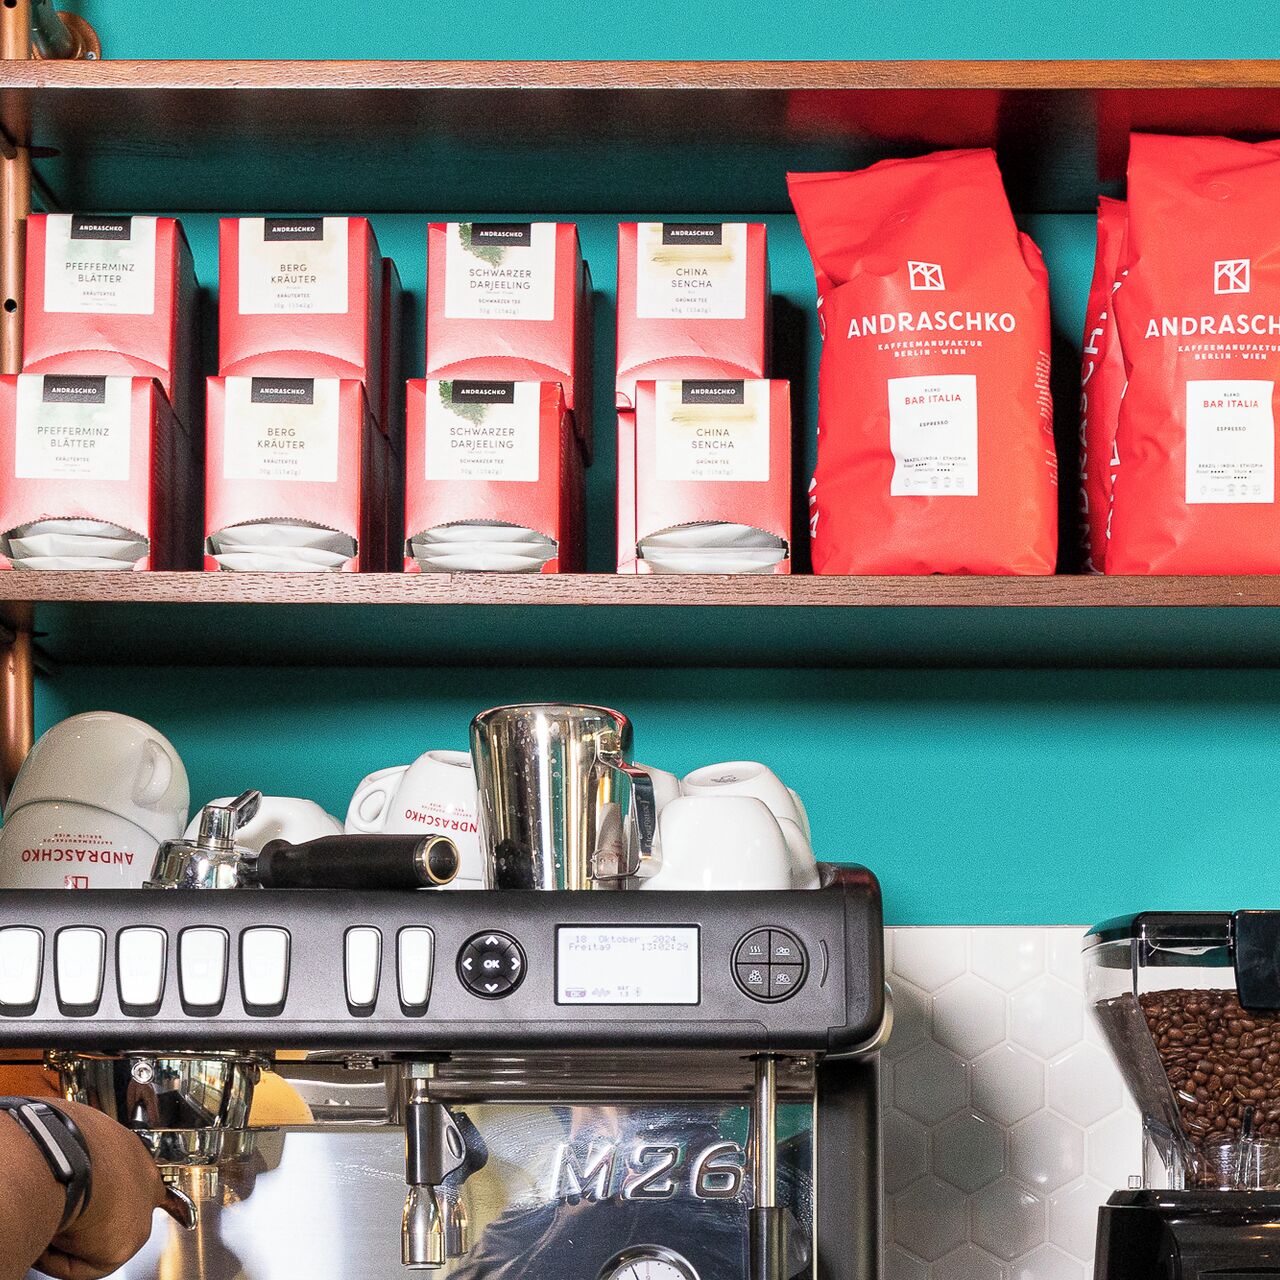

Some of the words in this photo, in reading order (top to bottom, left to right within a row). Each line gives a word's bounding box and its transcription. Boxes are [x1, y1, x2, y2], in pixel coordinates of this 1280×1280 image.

[65, 262, 135, 272] PFEFFERMINZ
[280, 264, 308, 272] BERG
[675, 268, 708, 276] CHINA
[78, 272, 122, 283] BLÄTTER
[469, 269, 532, 278] SCHWARZER
[271, 274, 317, 284] KRÄUTER
[671, 280, 713, 288] SENCHA
[470, 281, 531, 291] DARJEELING
[847, 311, 1016, 339] ANDRASCHKO
[878, 340, 983, 351] KAFFEEMANUFAKTUR
[894, 349, 930, 358] BERLIN
[905, 396, 925, 405] BAR
[928, 394, 962, 403] ITALIA
[1203, 400, 1224, 408] BAR
[1227, 400, 1259, 408] ITALIA
[37, 426, 110, 437] PFEFFERMINZ
[267, 428, 296, 437] BERG
[450, 428, 515, 436] SCHWARZER
[696, 429, 730, 437] CHINA
[50, 437, 96, 448] BLÄTTER
[257, 439, 306, 449] KRÄUTER
[451, 440, 514, 450] DARJEELING
[691, 441, 735, 449] SENCHA
[405, 809, 478, 833] NDRASCHKO
[22, 849, 134, 865] ANDRASCHKO
[599, 935, 640, 943] Oktober
[652, 935, 676, 943] 2024
[568, 943, 611, 951] Freitag
[483, 960, 500, 968] OK
[551, 1141, 747, 1201] M26
